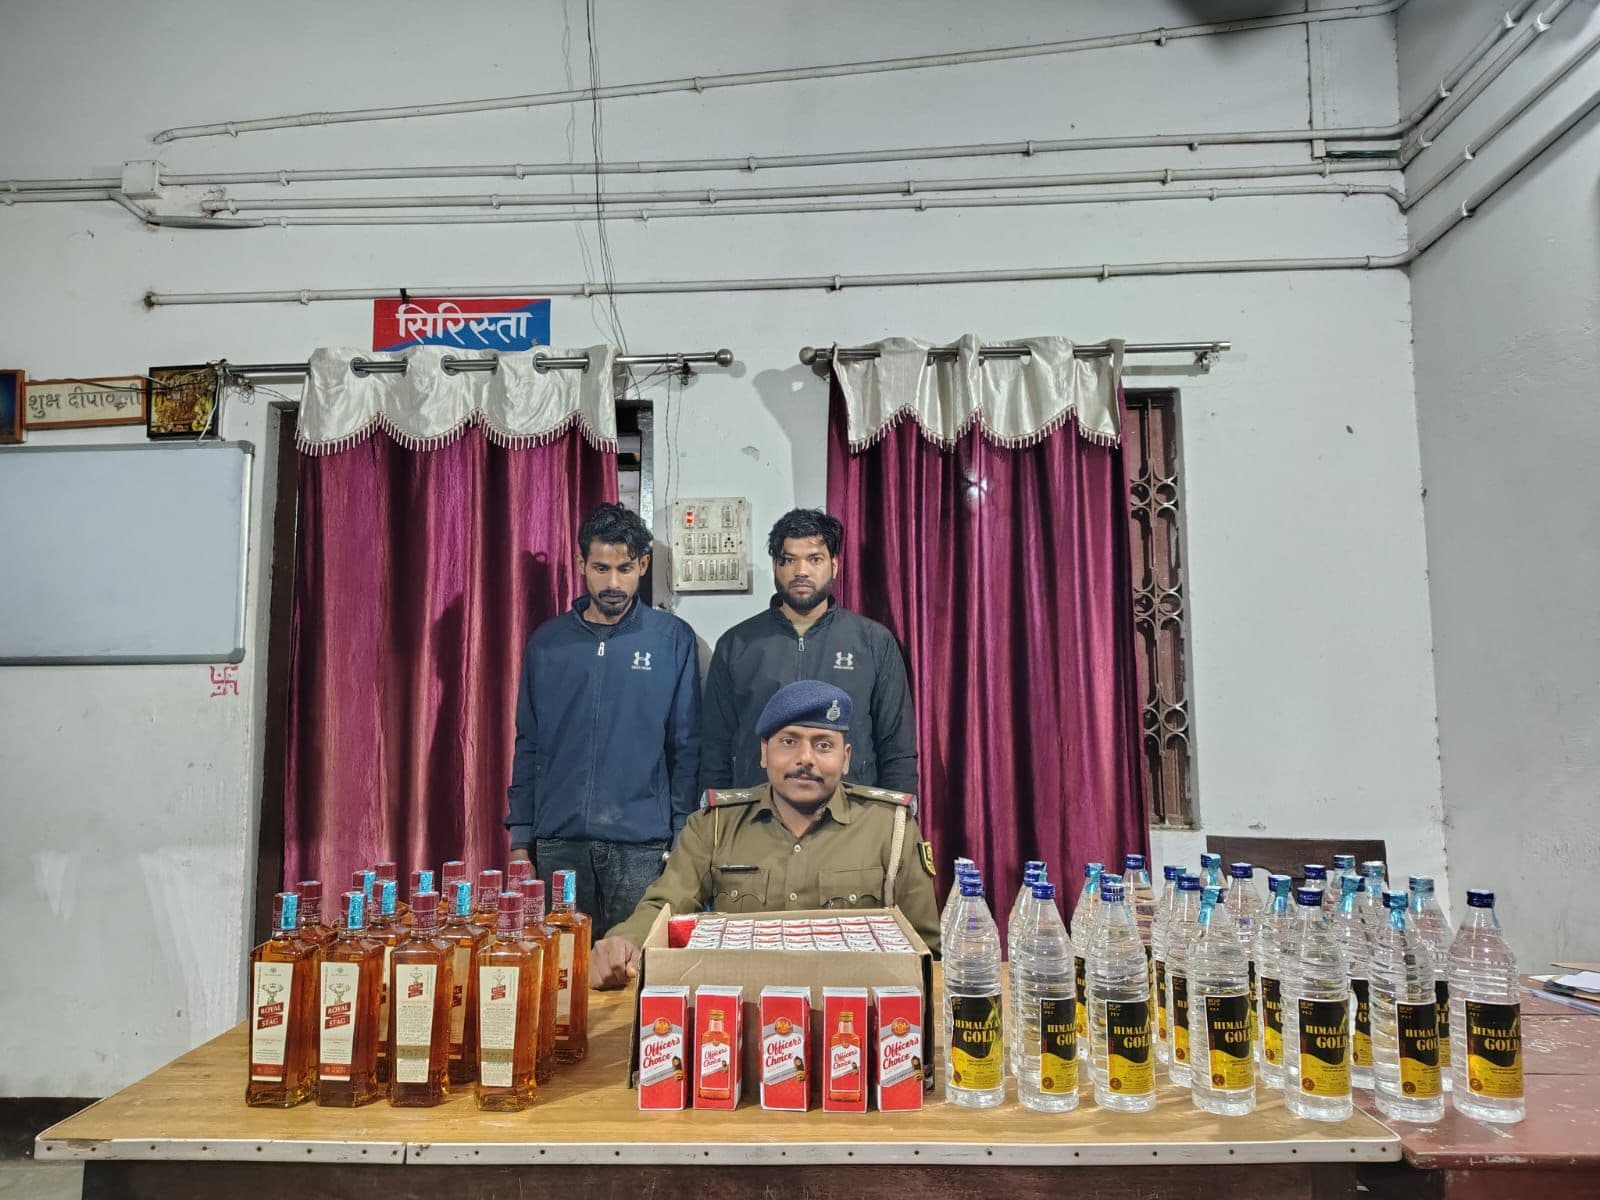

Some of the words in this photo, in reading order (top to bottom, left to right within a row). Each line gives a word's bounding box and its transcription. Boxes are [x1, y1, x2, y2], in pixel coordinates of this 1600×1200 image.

[395, 302, 534, 345] सिरिस्ता
[28, 392, 62, 418] शुभ
[260, 1005, 281, 1014] ROYAL
[327, 1005, 349, 1014] ROYAL
[261, 1017, 279, 1027] STAG
[328, 1017, 346, 1027] STAG
[963, 1030, 996, 1043] GOLD
[643, 1052, 672, 1068] Choice
[765, 1052, 793, 1068] Choice
[882, 1053, 910, 1070] Choice
